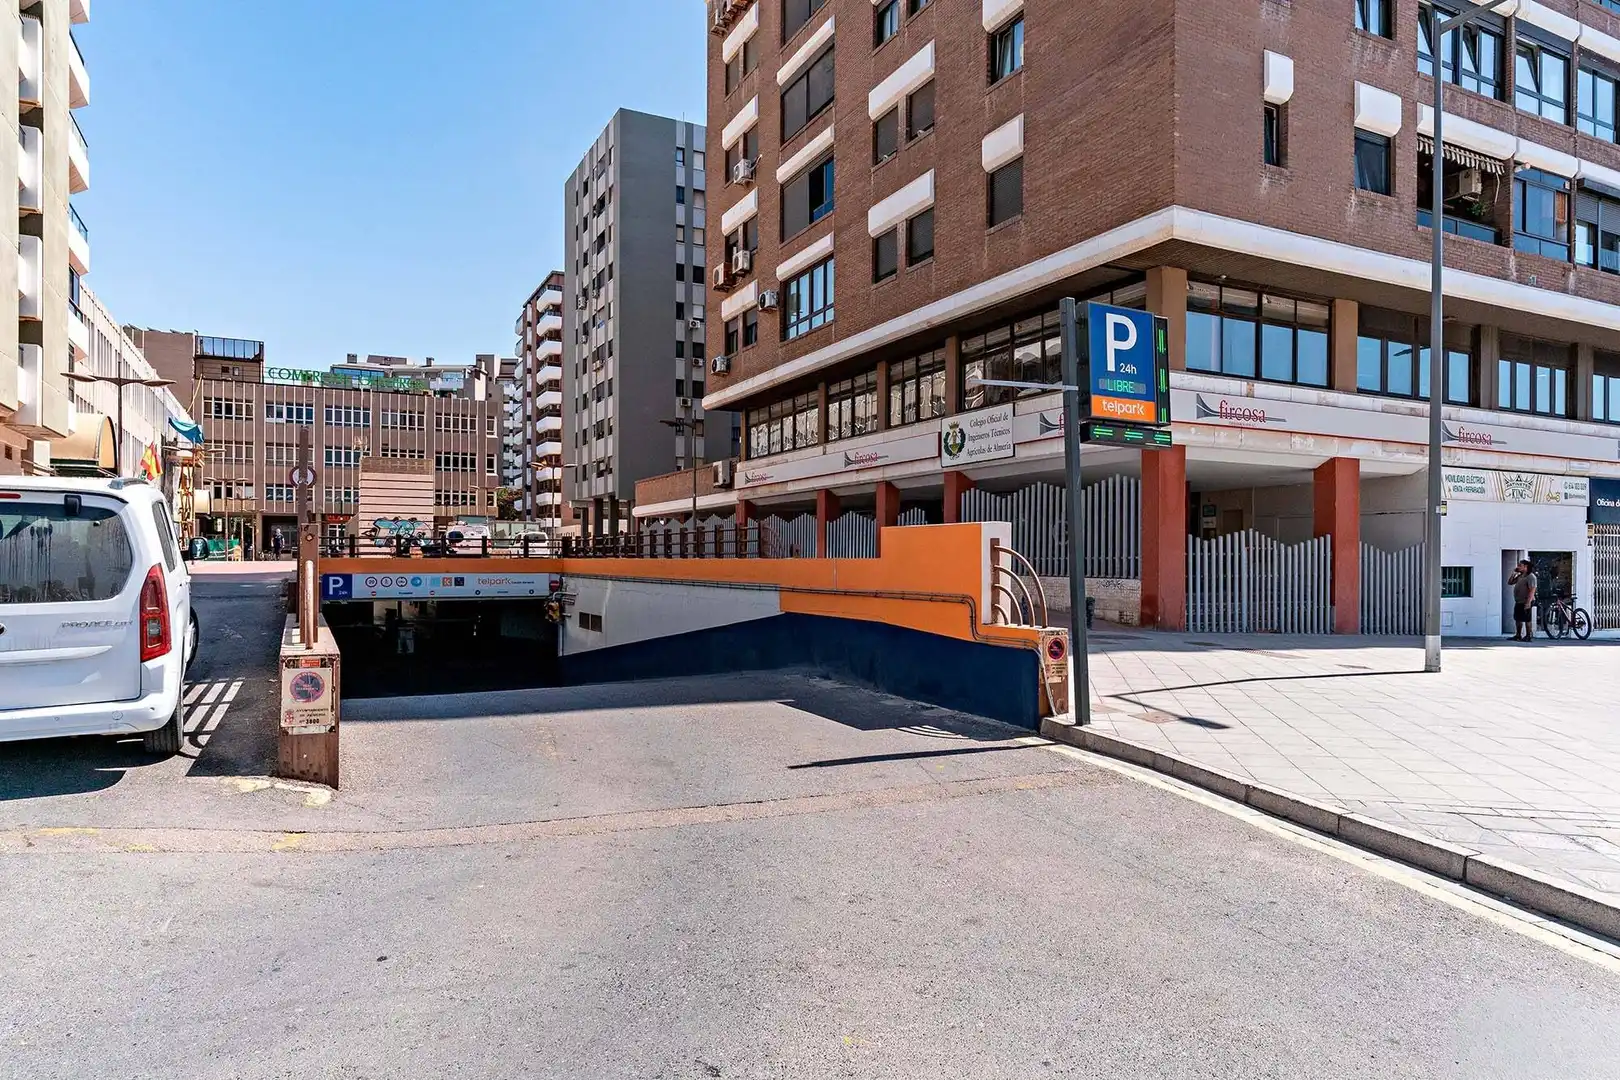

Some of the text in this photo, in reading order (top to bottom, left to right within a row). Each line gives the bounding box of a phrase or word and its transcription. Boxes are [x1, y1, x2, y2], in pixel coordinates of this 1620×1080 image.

[1105, 313, 1138, 375] P 24h
[1107, 378, 1135, 394] LIBRE
[1101, 400, 1145, 415] telpark
[1219, 399, 1267, 423] fircosa
[969, 411, 1009, 429] Colegio Oficial de
[967, 427, 1011, 444] Ingenieros Técnicos
[1458, 426, 1492, 445] fircosa
[966, 446, 986, 458] Agrícolas
[987, 444, 993, 453] de
[993, 441, 1012, 452] Almería
[1596, 498, 1615, 507] Oficina
[328, 576, 344, 595] P
[477, 576, 511, 586] telpark
